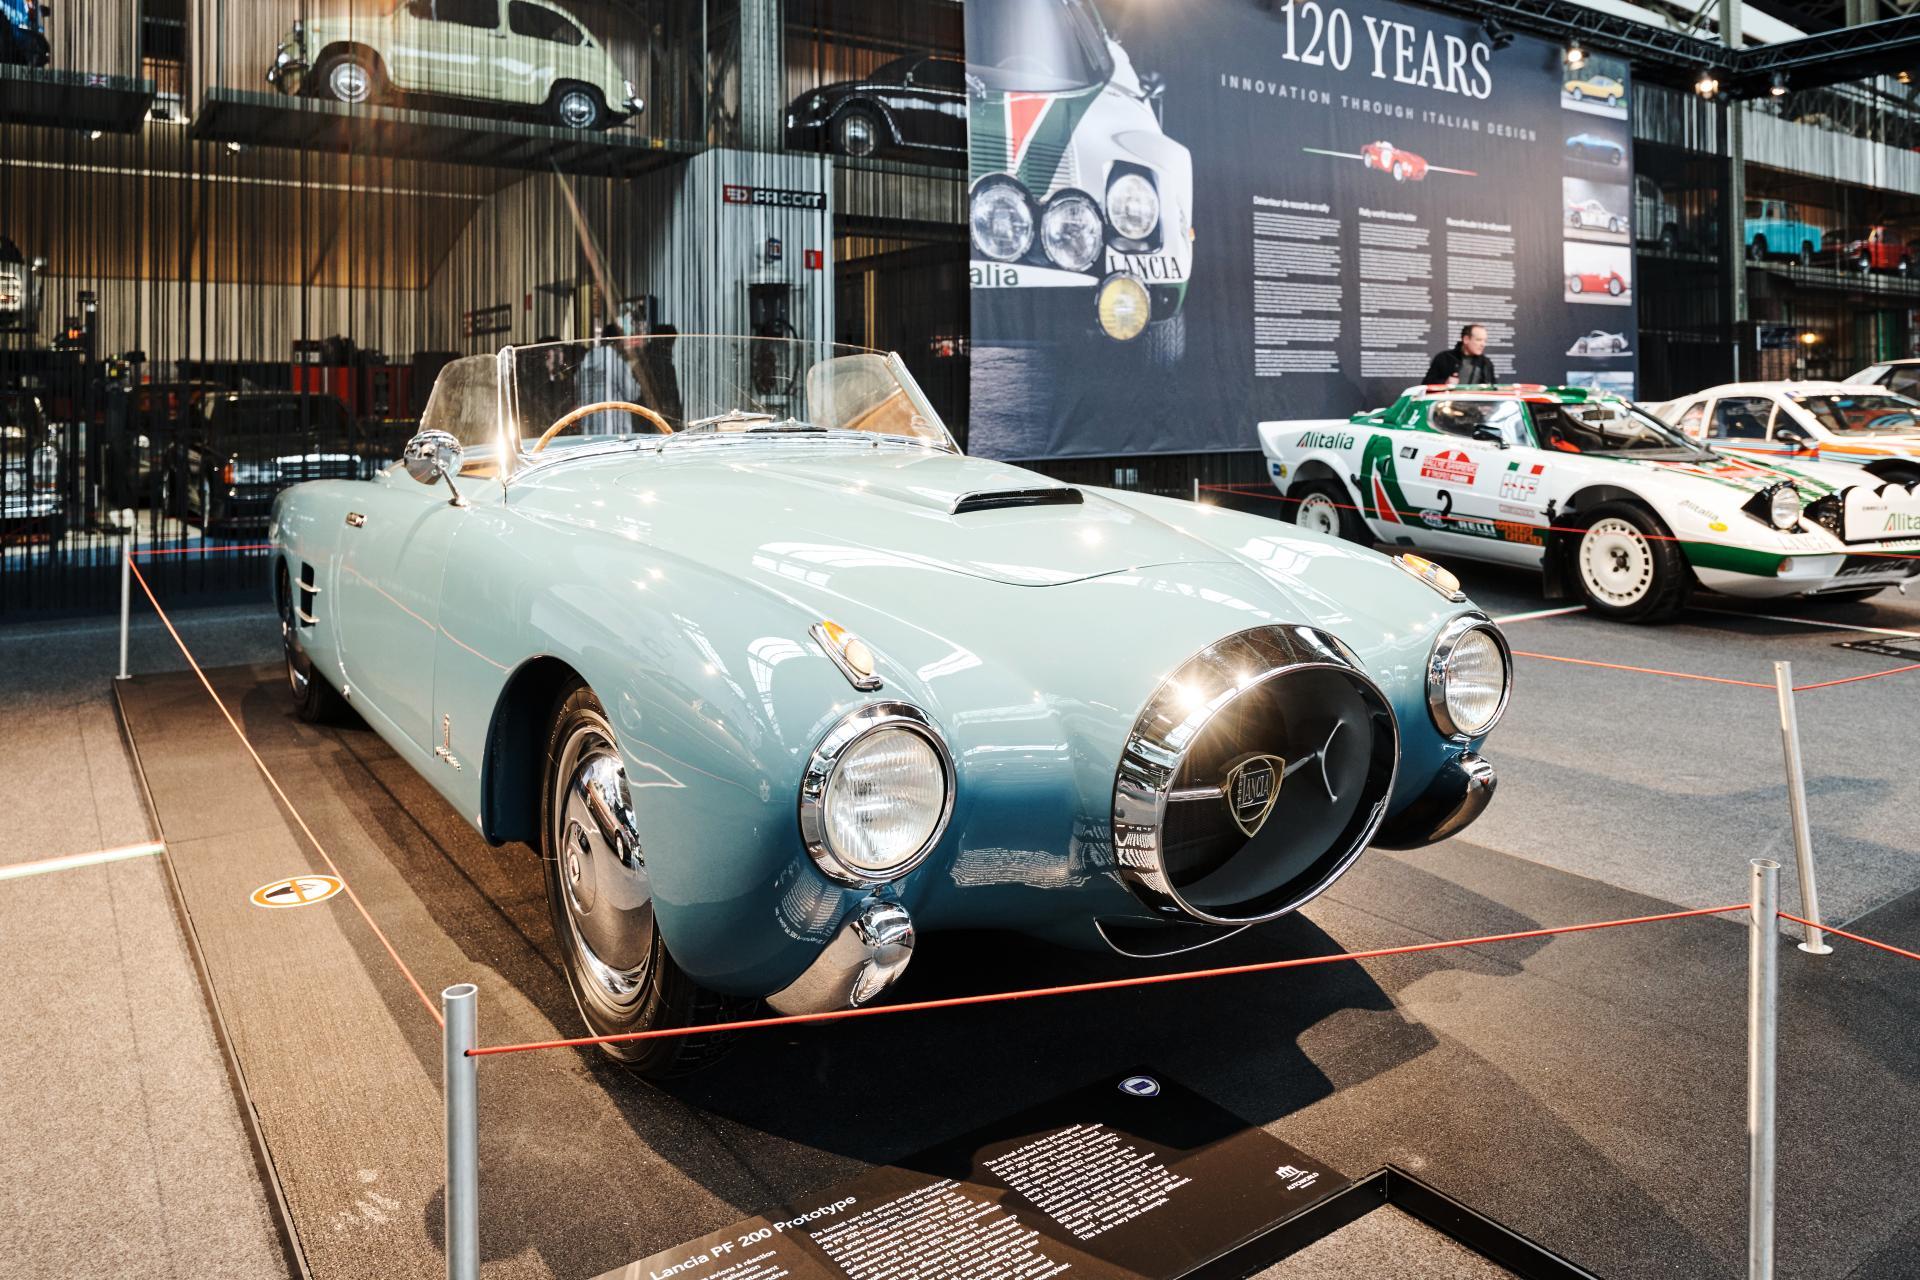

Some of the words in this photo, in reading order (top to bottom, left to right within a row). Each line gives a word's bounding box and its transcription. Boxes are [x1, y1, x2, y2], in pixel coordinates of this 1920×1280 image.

[1281, 0, 1352, 71] 120
[1362, 15, 1492, 100] YEARS
[1221, 73, 1330, 105] INNOVATION
[1340, 95, 1414, 120] THROUGH
[1423, 109, 1479, 131] ITALIAN
[1487, 122, 1536, 142] DESIGN
[970, 263, 1019, 286] alia
[1110, 254, 1183, 280] LANCIA
[1296, 431, 1354, 450] Alitalia
[1437, 489, 1453, 525] 2
[1243, 773, 1270, 806] LANCIA
[649, 1254, 709, 1280] Lancia
[710, 1241, 734, 1257] PF
[738, 1228, 772, 1247] 200
[773, 1197, 856, 1232] Prototype
